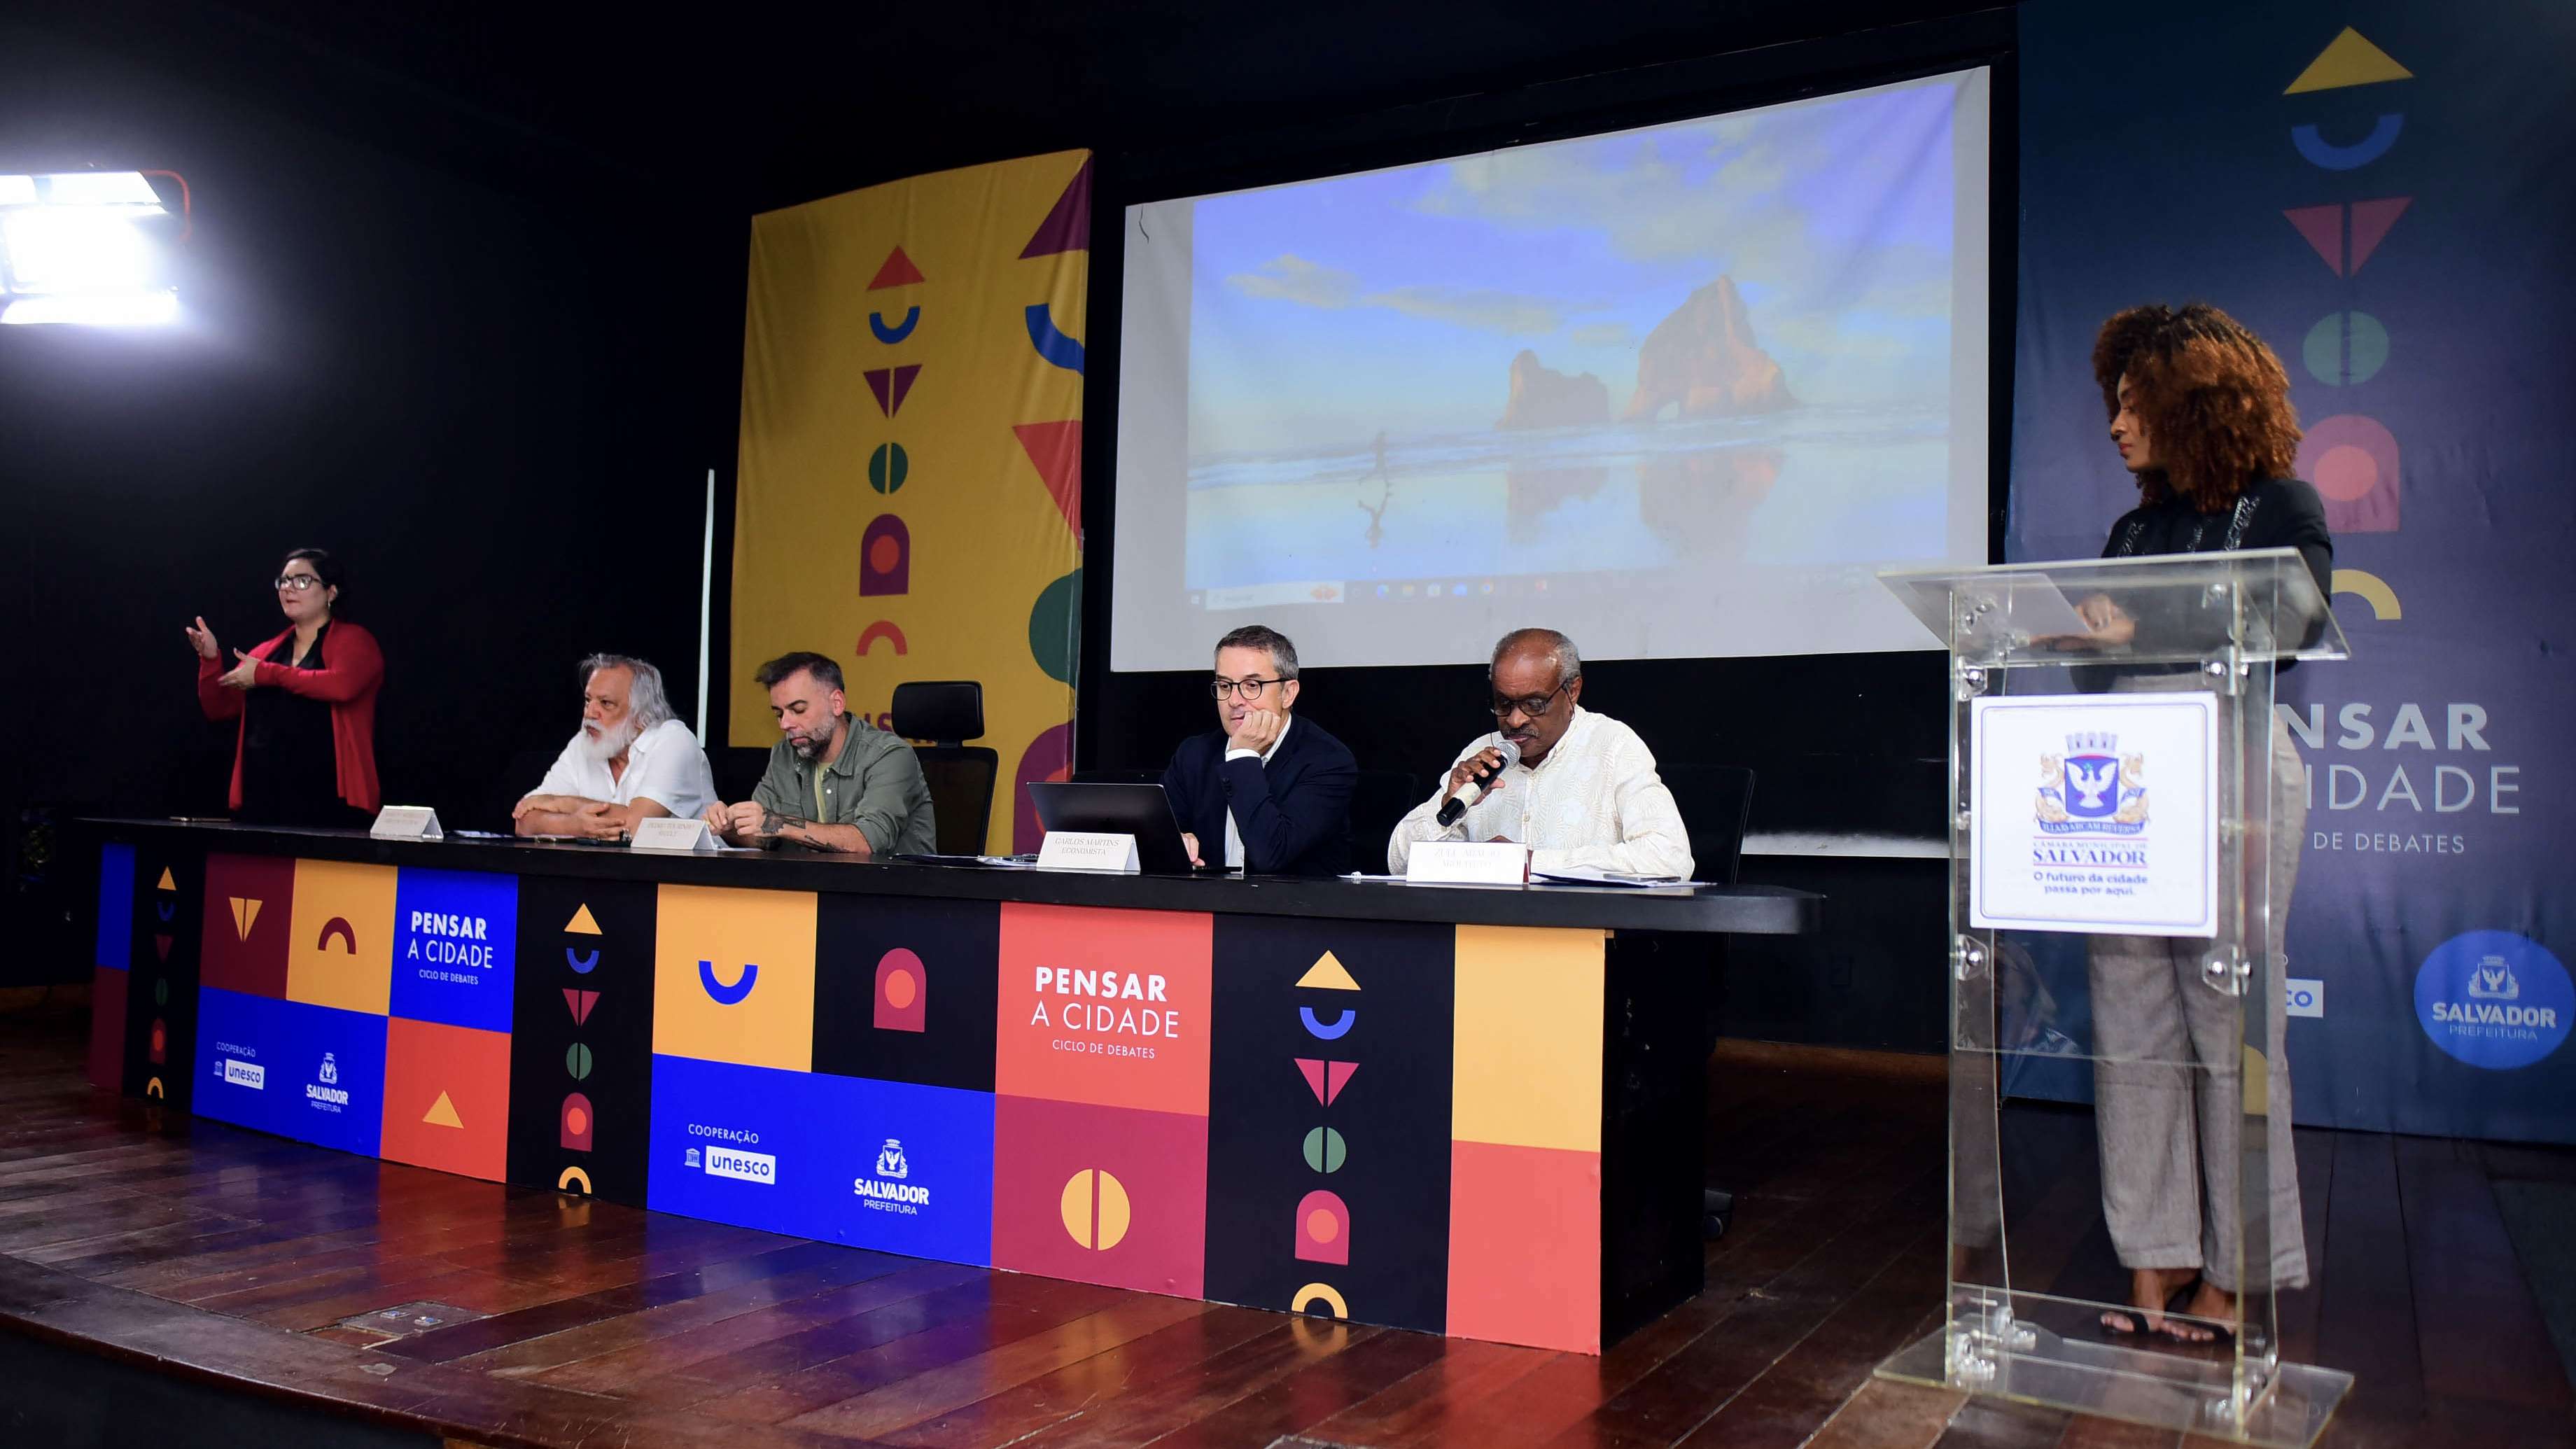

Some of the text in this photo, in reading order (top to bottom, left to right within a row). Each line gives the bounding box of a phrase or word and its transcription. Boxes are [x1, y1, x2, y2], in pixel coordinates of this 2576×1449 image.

[2275, 703, 2491, 750] NSAR
[2306, 764, 2520, 814] IDADE
[1054, 837, 1084, 846] CARLOS
[2314, 832, 2465, 854] DE DEBATES
[2033, 848, 2146, 864] SALVADOR
[2033, 872, 2148, 884] O futuro da cidade
[2044, 885, 2078, 895] passa
[2081, 886, 2101, 895] por
[411, 910, 487, 940] PENSAR
[407, 937, 493, 969] A CIDADE
[419, 969, 479, 985] CICLO DE DEBATES
[1035, 966, 1167, 1002] PENSAR
[1030, 1000, 1180, 1039] A CIDADE
[2432, 1002, 2556, 1028] SALVADOR
[2449, 1025, 2538, 1041] PREFEITURA
[216, 1041, 256, 1058] COOPERAÇÃO
[1051, 1039, 1155, 1059] CICLO DE DEBATES
[228, 1065, 261, 1084] unesco
[306, 1084, 349, 1105] SALVADOR
[311, 1100, 342, 1114] PREFEITURA
[688, 1123, 760, 1144] COOPERAÇÃO
[712, 1154, 770, 1176] unesco
[854, 1178, 930, 1205] SALVADOR
[864, 1198, 918, 1216] PREFEITURA
